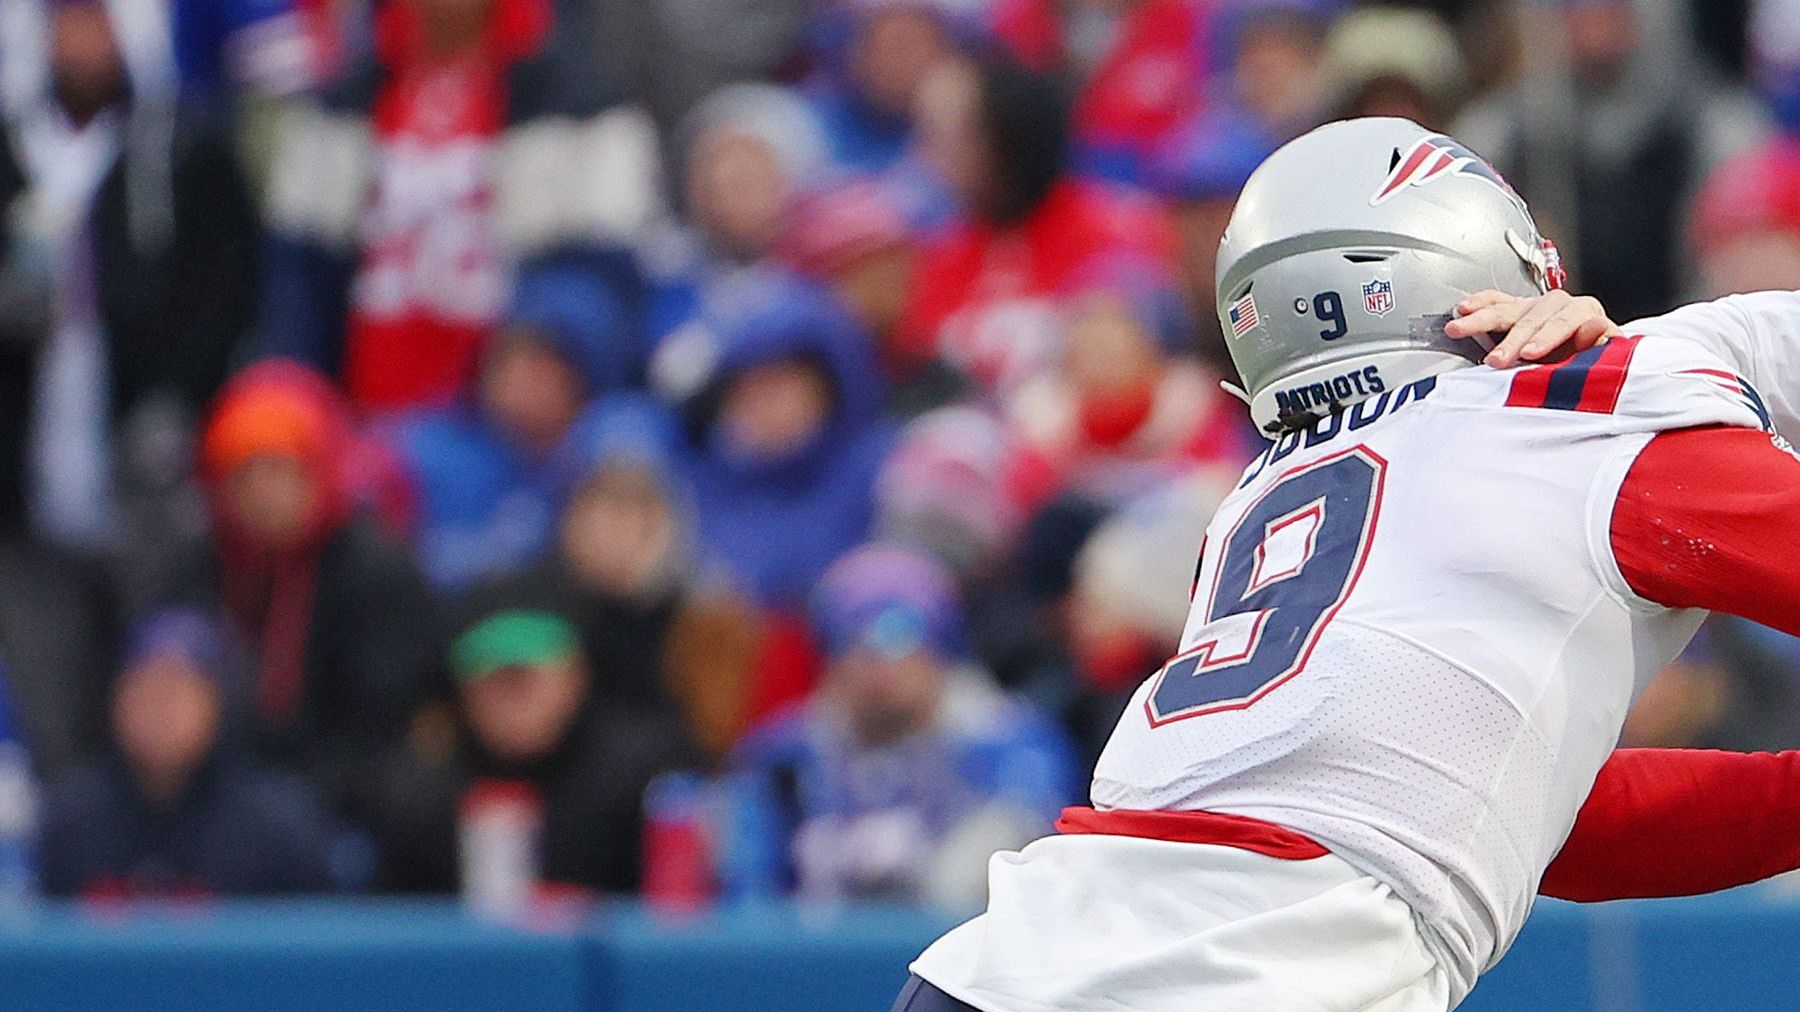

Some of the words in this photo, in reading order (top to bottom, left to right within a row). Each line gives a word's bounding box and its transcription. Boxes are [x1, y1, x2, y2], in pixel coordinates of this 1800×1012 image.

[1313, 291, 1348, 341] 9
[1367, 295, 1392, 313] NFL
[1275, 365, 1386, 414] PATRIOTS
[1143, 442, 1389, 729] 9
